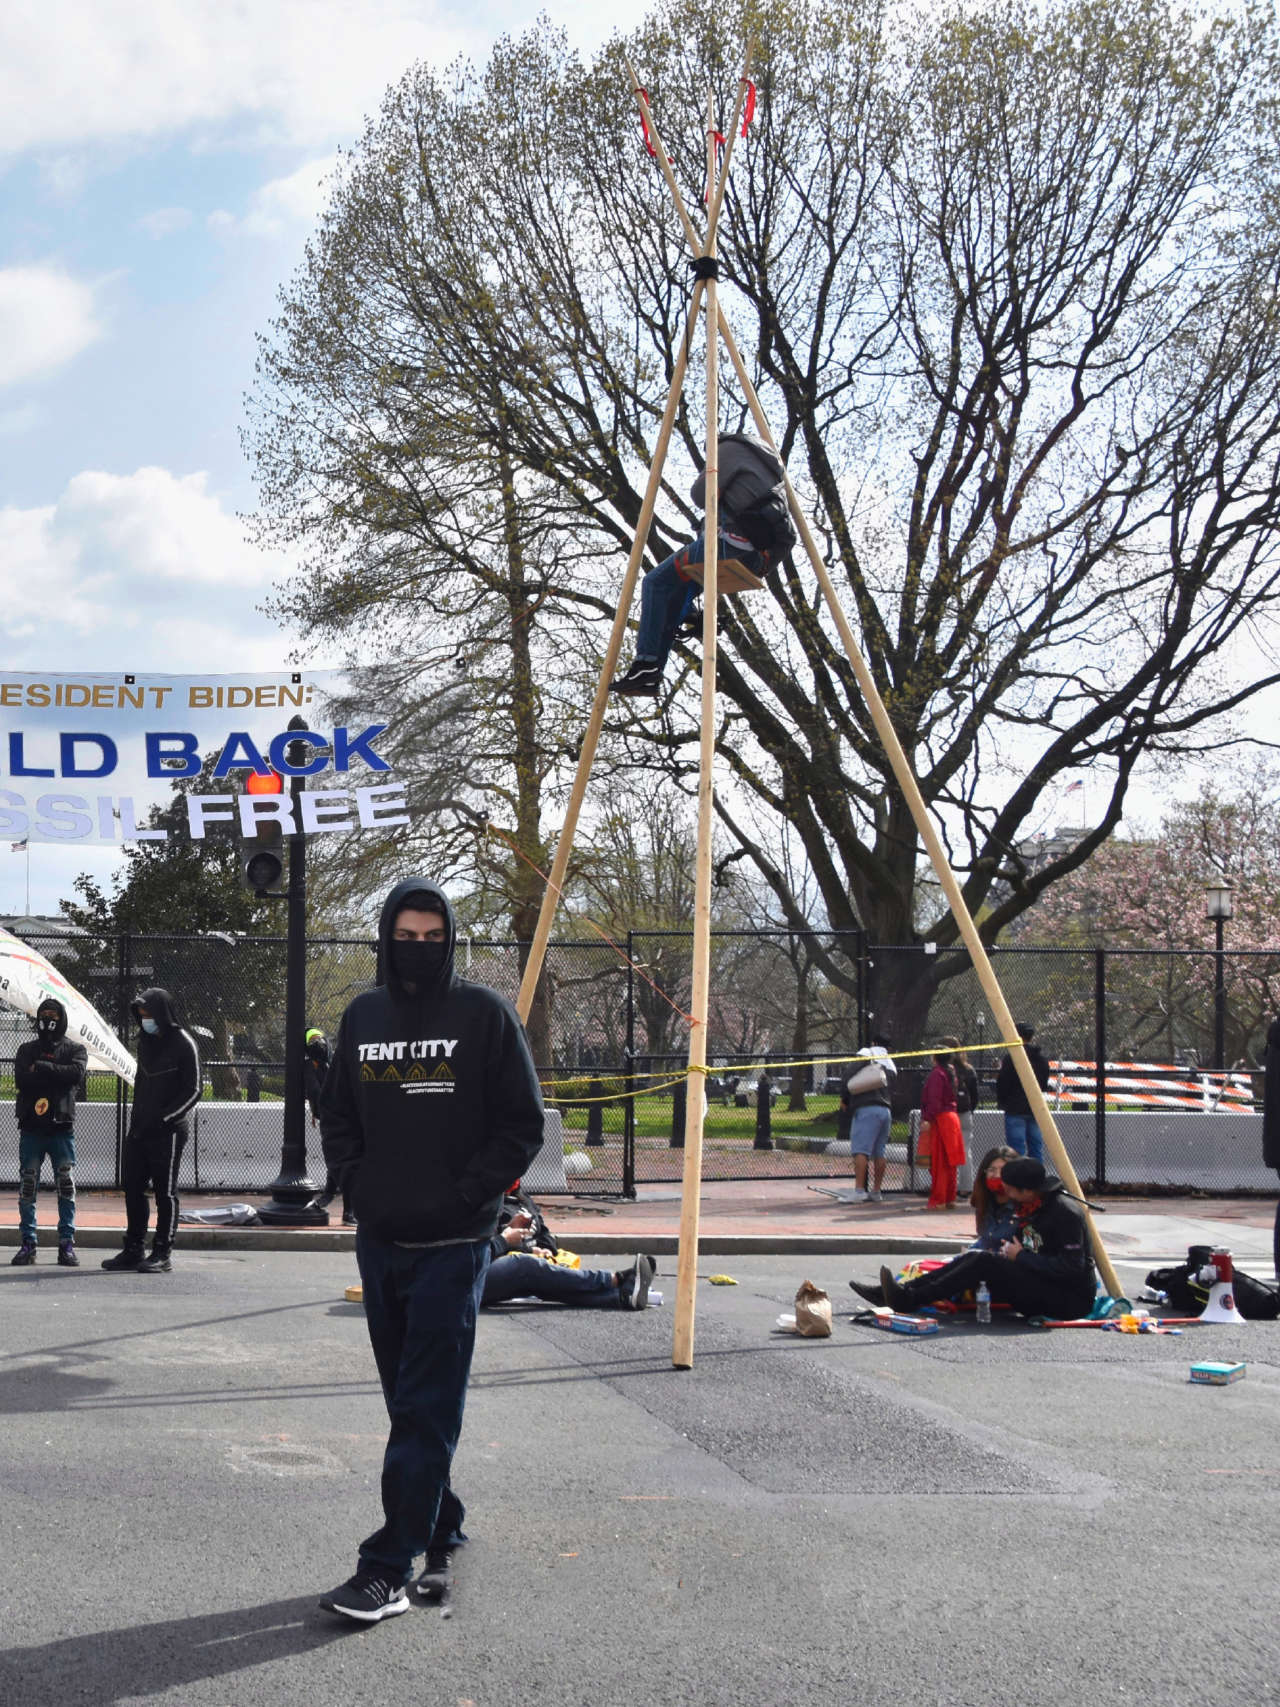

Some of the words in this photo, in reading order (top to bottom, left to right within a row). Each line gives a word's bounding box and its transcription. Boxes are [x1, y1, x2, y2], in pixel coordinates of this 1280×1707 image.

[188, 685, 313, 709] BIDEN:
[145, 724, 393, 779] BACK
[186, 782, 411, 840] FREE
[358, 1042, 408, 1061] TENT
[410, 1040, 459, 1059] CITY
